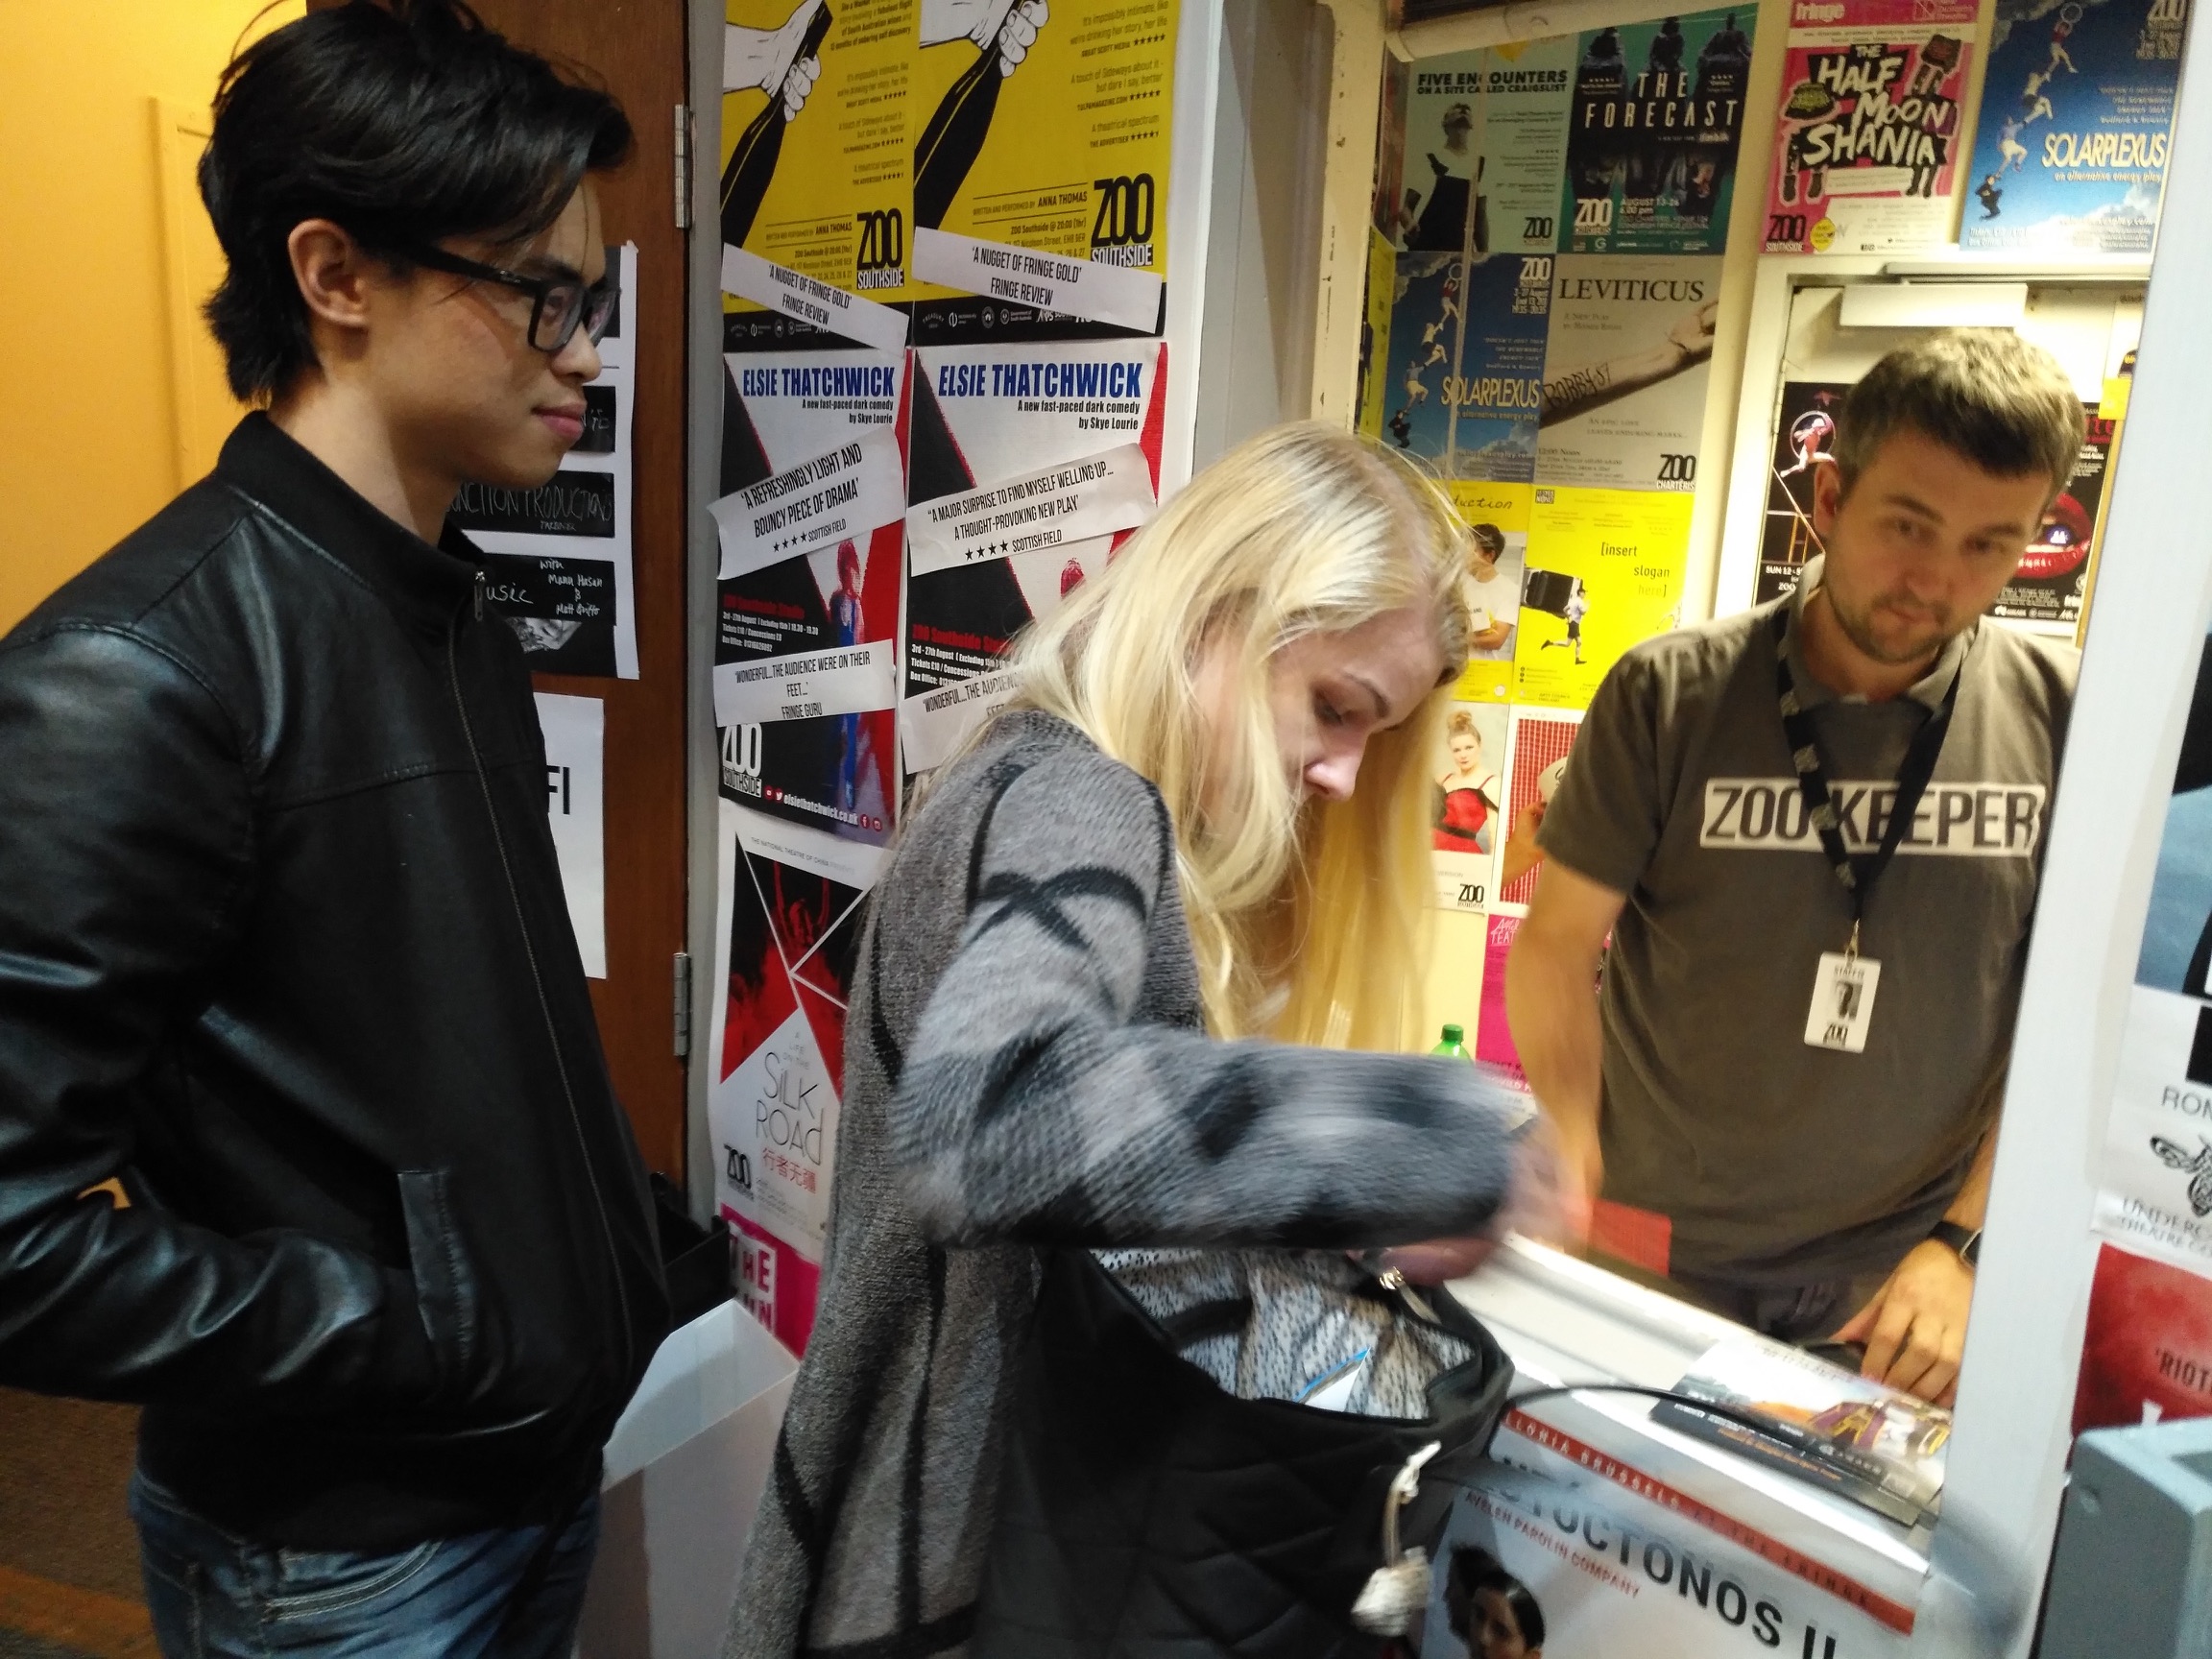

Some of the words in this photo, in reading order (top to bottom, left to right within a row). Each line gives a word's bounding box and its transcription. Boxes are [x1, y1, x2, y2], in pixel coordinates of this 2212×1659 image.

[1855, 44, 1883, 58] THE
[1417, 86, 1431, 95] ON
[1445, 85, 1465, 94] SITE
[1467, 84, 1505, 94] CALED
[1507, 84, 1567, 93] CRAIGSLIST
[1418, 73, 1453, 86] FIVE
[1638, 72, 1689, 98] THE
[1817, 55, 1903, 96] HALF
[1585, 100, 1738, 129] FORECAST
[1804, 122, 1936, 167] SHANIA
[2042, 132, 2168, 168] SOLARPLEXUS
[2067, 170, 2112, 181] alternative
[2113, 172, 2140, 183] energy
[1038, 196, 1057, 207] ANNA
[1059, 191, 1088, 204] THOMAS
[1091, 173, 1154, 248] ZOO
[1575, 198, 1614, 227] ZOO
[856, 207, 902, 270] ZOO
[1524, 216, 1553, 238] ZOO
[1767, 214, 1807, 242] ZOO
[972, 246, 980, 262] 'A
[980, 248, 1011, 271] NUGGET
[1012, 255, 1023, 272] OF
[1023, 259, 1055, 279] FRINGE
[1055, 265, 1083, 284] GOLD'
[1091, 245, 1153, 268] SOUTHSIDE
[1520, 257, 1552, 280] ZOO
[769, 264, 775, 279] 'A
[775, 266, 800, 287] NUGGET
[799, 276, 808, 292] OF
[807, 280, 832, 303] FRINGE
[831, 289, 853, 310] GOLD'
[857, 268, 904, 289] SOUTHSIDE
[990, 276, 1020, 299] FRINGE
[1020, 283, 1054, 306] REVIEW
[1559, 277, 1704, 302] LEVITICUS
[781, 293, 805, 315] FRINGE
[805, 301, 830, 325] REVIEW
[743, 368, 778, 397] ELSIE
[781, 366, 895, 397] THATCHWICK
[938, 365, 987, 397] ELSIE
[992, 363, 1142, 397] THATCHWICK
[1441, 376, 1540, 409] SOLARPLEXUS
[802, 398, 806, 409] A
[806, 400, 819, 409] new
[819, 398, 853, 411] fast-paced
[854, 398, 869, 410] dark
[869, 399, 894, 412] comedy
[849, 413, 857, 424] by
[857, 413, 873, 425] Skye
[874, 413, 893, 424] Lourie
[1018, 400, 1023, 412] A
[1023, 401, 1040, 412] new
[1041, 399, 1084, 414] fast-paced
[1085, 400, 1105, 414] dark
[1106, 402, 1141, 415] comedy
[1078, 417, 1090, 430] by
[1090, 417, 1110, 430] Skye
[1111, 417, 1139, 430] Lourie
[741, 491, 754, 511] 'A
[754, 463, 814, 507] REFRESHINGLY
[814, 451, 841, 480] LIGHT
[843, 443, 863, 470] AND
[1658, 453, 1696, 481] ZOO
[938, 505, 963, 522] MAJOR
[963, 492, 998, 516] SURPRISE
[998, 490, 1008, 505] TO
[1008, 485, 1026, 503] FIND
[1025, 475, 1056, 498] MYSELF
[1056, 465, 1094, 489] WELLING
[1094, 461, 1115, 481] UP...
[1656, 480, 1695, 491] CHARTERIS
[754, 506, 788, 539] BOUNCY
[787, 497, 812, 525] PIECE
[814, 493, 825, 515] OF
[825, 477, 860, 511] DRAMA'
[953, 526, 960, 541] A
[960, 508, 1038, 541] THOUGHT-PROVOKING
[1038, 504, 1056, 521] NEW
[1057, 494, 1081, 516] PLAY'
[807, 524, 832, 543] SCOTTISH
[832, 517, 847, 535] FIELD
[1012, 533, 1044, 553] SCOTTISH
[1044, 529, 1063, 545] FIELD
[1600, 541, 1638, 557] [insert
[1634, 565, 1670, 580] slogan
[1638, 584, 1667, 598] here]
[784, 659, 816, 677] AUDIENCE
[818, 657, 837, 671] WERE
[838, 655, 849, 668] ON
[850, 650, 871, 666] THEIR
[910, 671, 921, 682] Box
[781, 703, 805, 719] FRINGE
[805, 702, 823, 717] GURU
[724, 767, 762, 798] SOUTHSIDE
[783, 793, 859, 826] elsiethatchwick.co.uk
[760, 840, 783, 853] NATIONAL
[784, 847, 805, 859] THEATRE
[1458, 883, 1485, 903] ZOO
[763, 1051, 819, 1120] SILK
[723, 1142, 752, 1190] ZOO
[2155, 1346, 2212, 1394] 'RIOT
[1580, 1447, 1681, 1510] BRUSSELS
[1571, 1551, 1641, 1599] COMPANY
